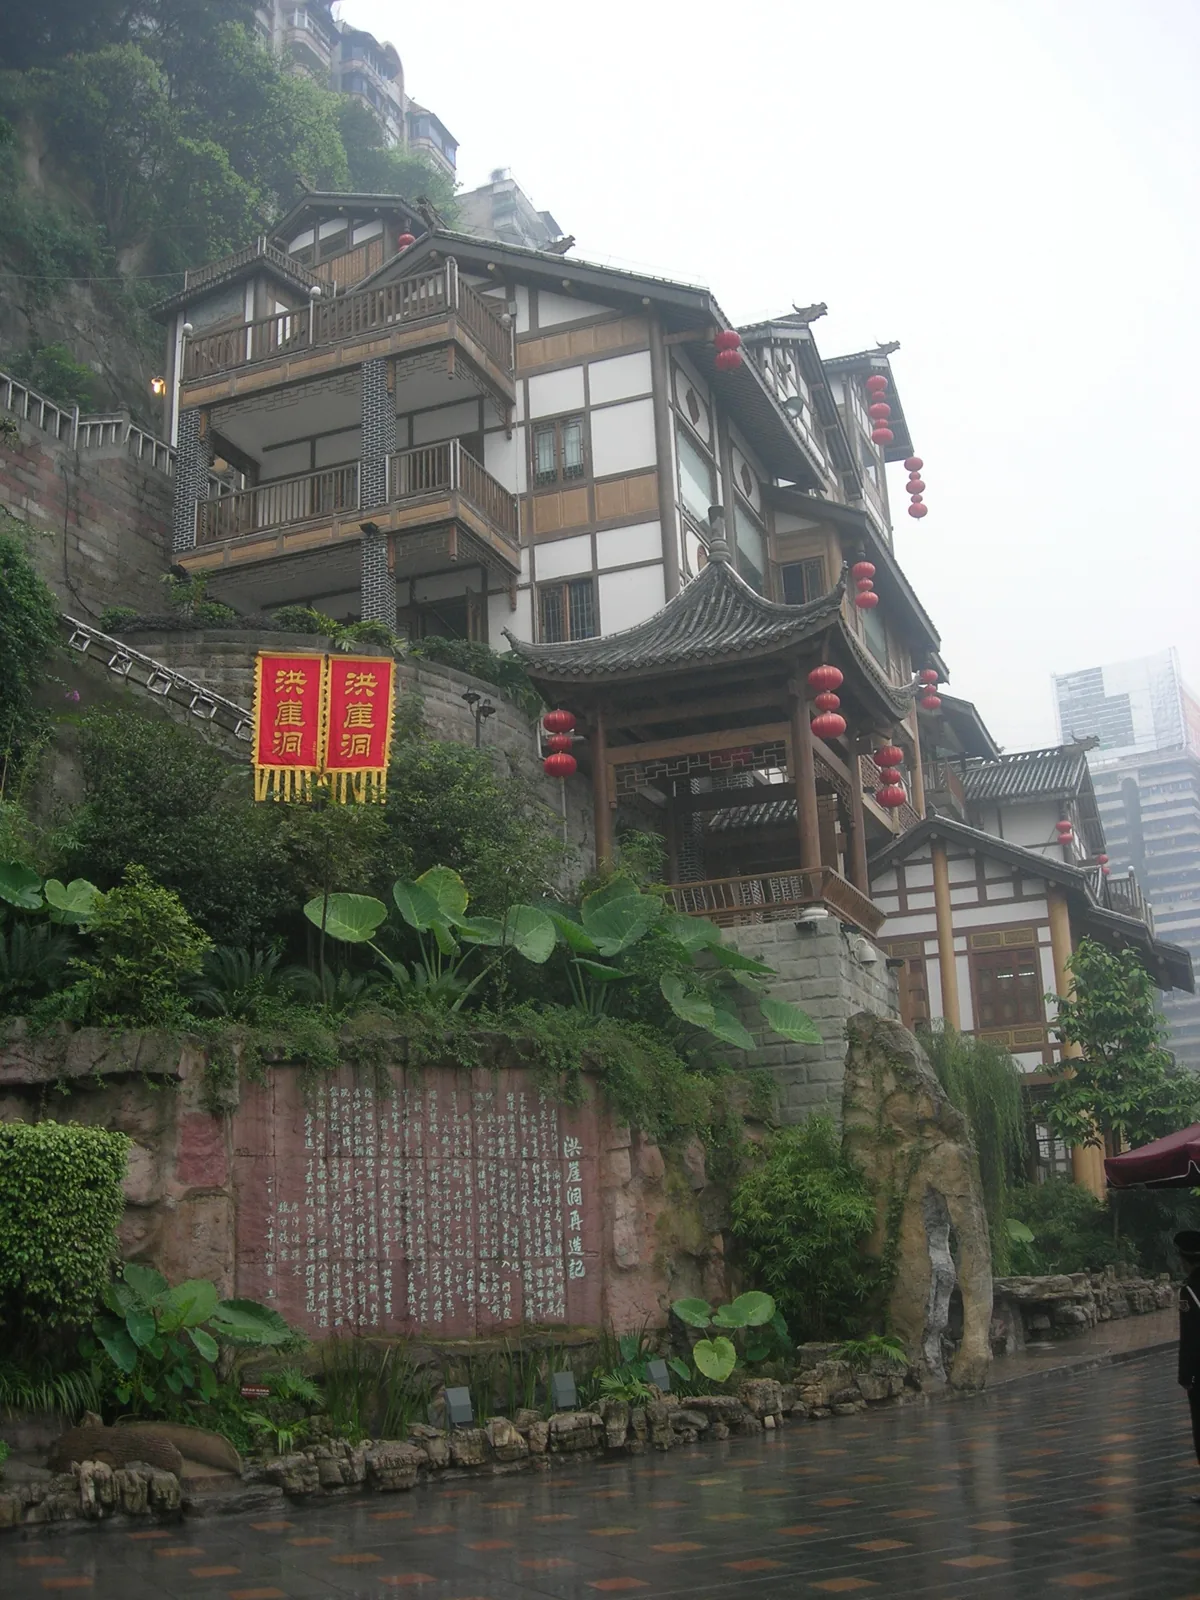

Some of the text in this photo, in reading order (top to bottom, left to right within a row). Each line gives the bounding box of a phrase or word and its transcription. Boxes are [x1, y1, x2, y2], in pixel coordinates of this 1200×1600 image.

[272, 671, 308, 757] 洪崖洞
[340, 673, 379, 759] 洪崖洞
[563, 1136, 586, 1279] 洪崖洞再造記
